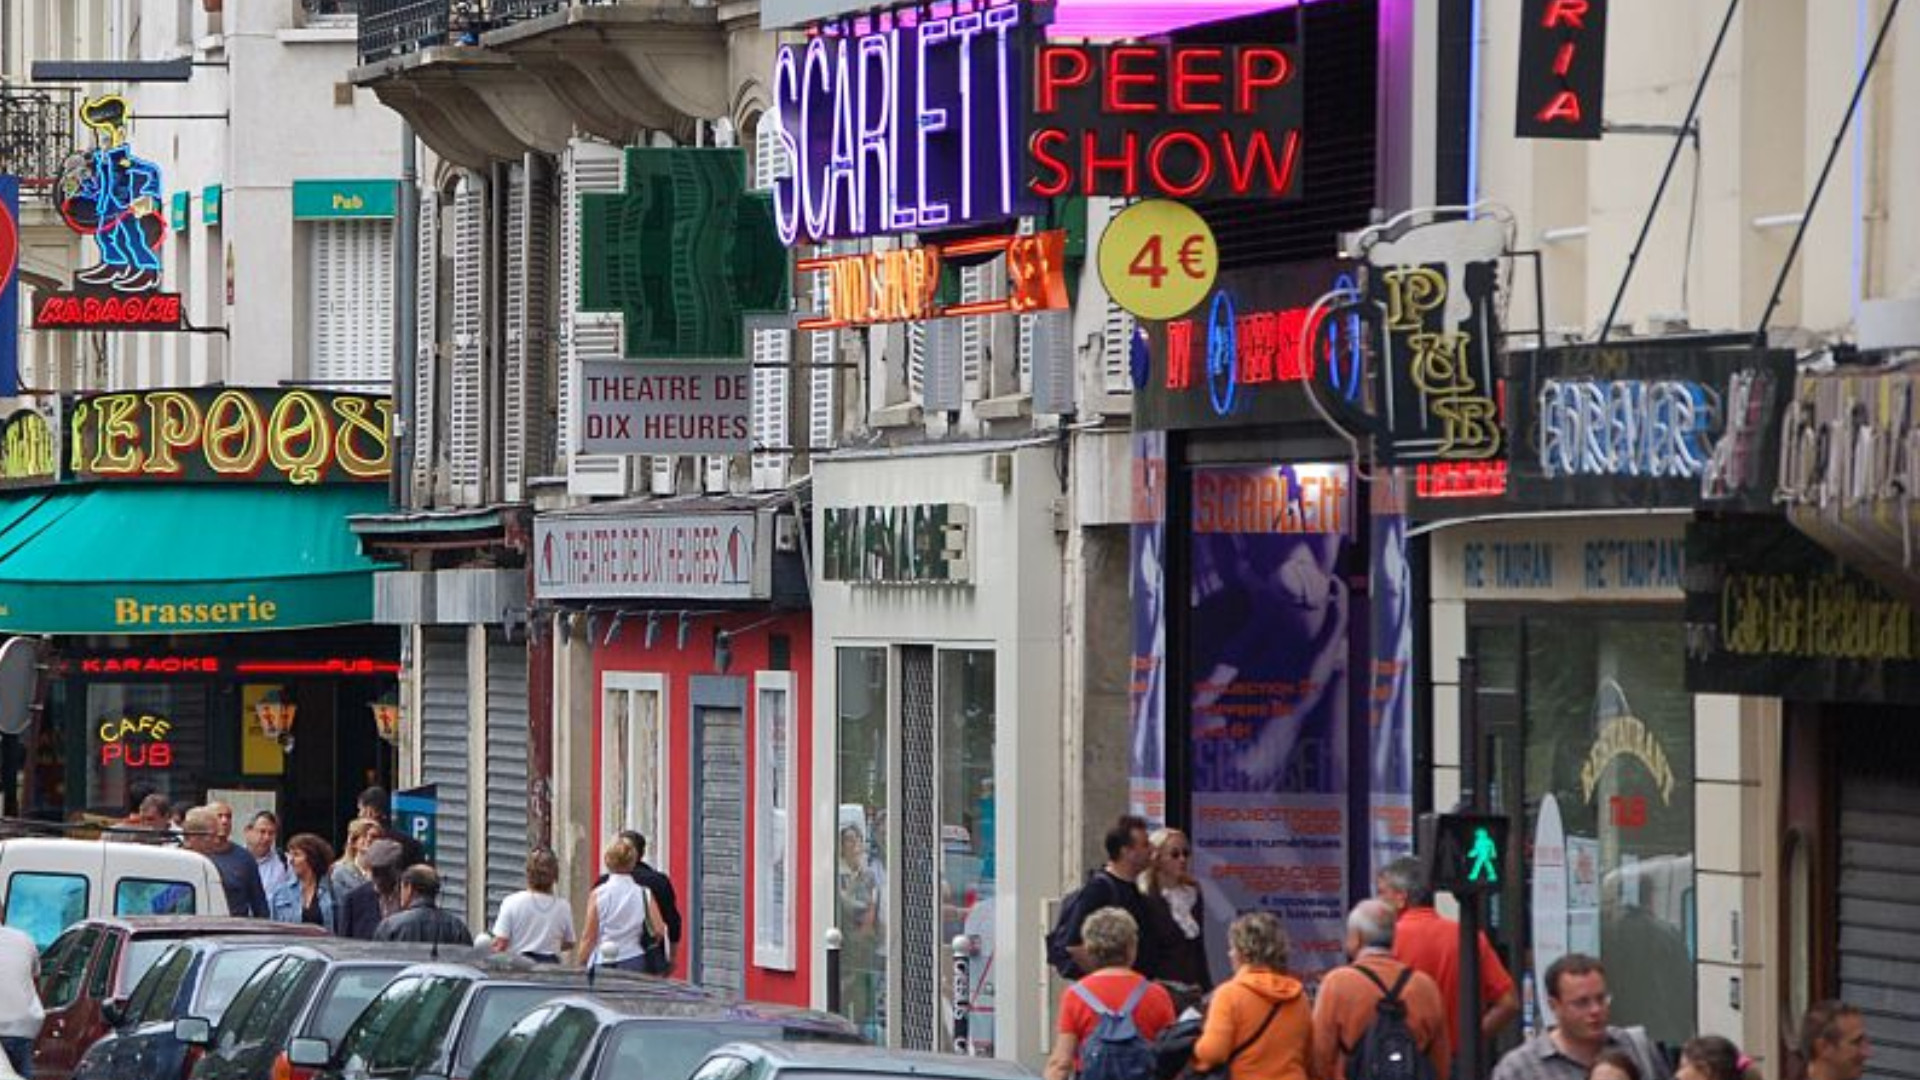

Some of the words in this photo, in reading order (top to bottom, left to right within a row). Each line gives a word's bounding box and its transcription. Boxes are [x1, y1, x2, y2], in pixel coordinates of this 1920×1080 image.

[1034, 46, 1291, 113] PEEP
[773, 3, 1019, 246] SCARLETT
[1028, 128, 1301, 197] SHOW
[332, 193, 363, 210] Pub
[38, 297, 180, 323] KARAOKE
[586, 375, 702, 402] THEATRE
[714, 374, 748, 401] DE
[586, 413, 630, 440] DIX
[644, 413, 749, 441] HEURES
[565, 527, 618, 583] THEATRE
[622, 527, 640, 582] DE
[642, 527, 663, 583] DIX
[667, 526, 720, 585] HEURES
[115, 595, 277, 625] Brasserie
[83, 658, 219, 673] KARAOKE
[328, 659, 374, 673] PUB
[100, 715, 172, 743] CAFE
[102, 743, 173, 767] PUB
[413, 816, 429, 842] P
